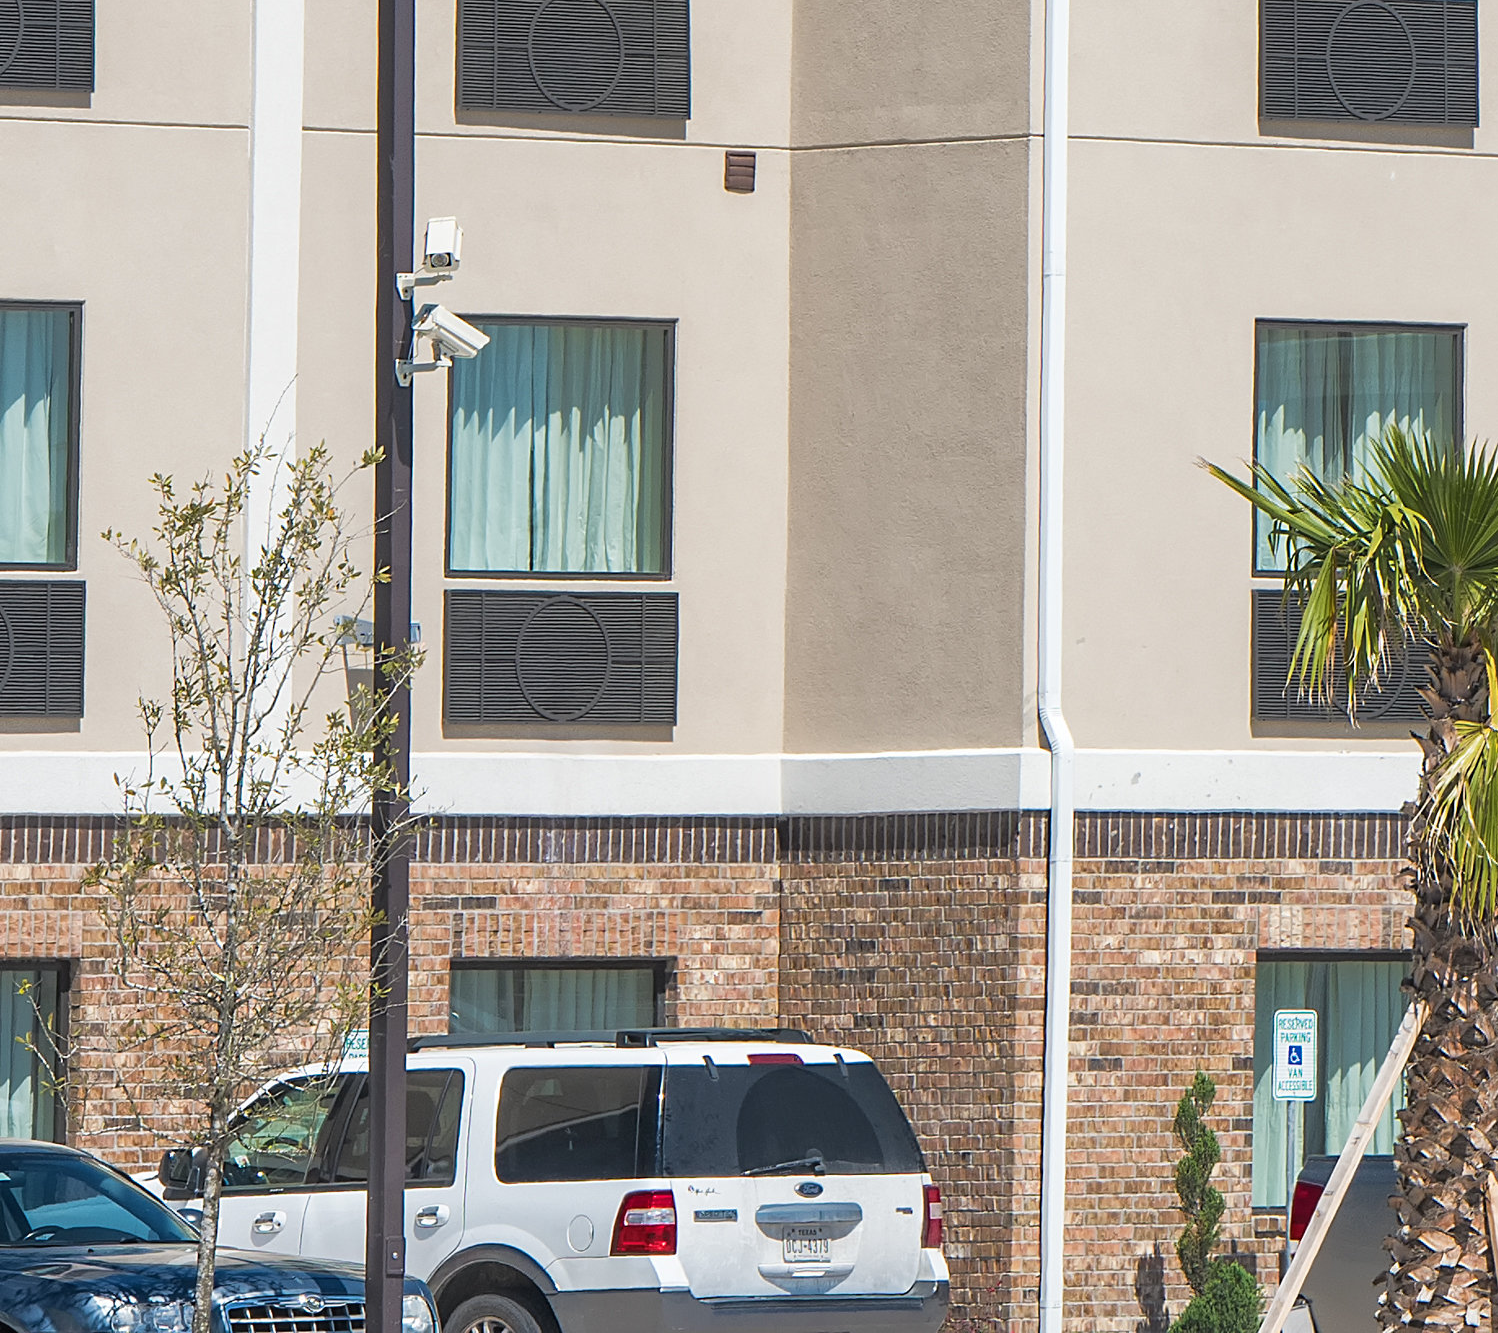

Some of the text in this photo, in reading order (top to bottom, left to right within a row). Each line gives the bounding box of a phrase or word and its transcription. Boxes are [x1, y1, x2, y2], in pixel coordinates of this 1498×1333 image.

[1279, 1017, 1313, 1030] RESERVED
[1280, 1031, 1312, 1043] PARKING
[1288, 1068, 1304, 1078] VAN
[1278, 1079, 1313, 1091] ACCESSIBLE
